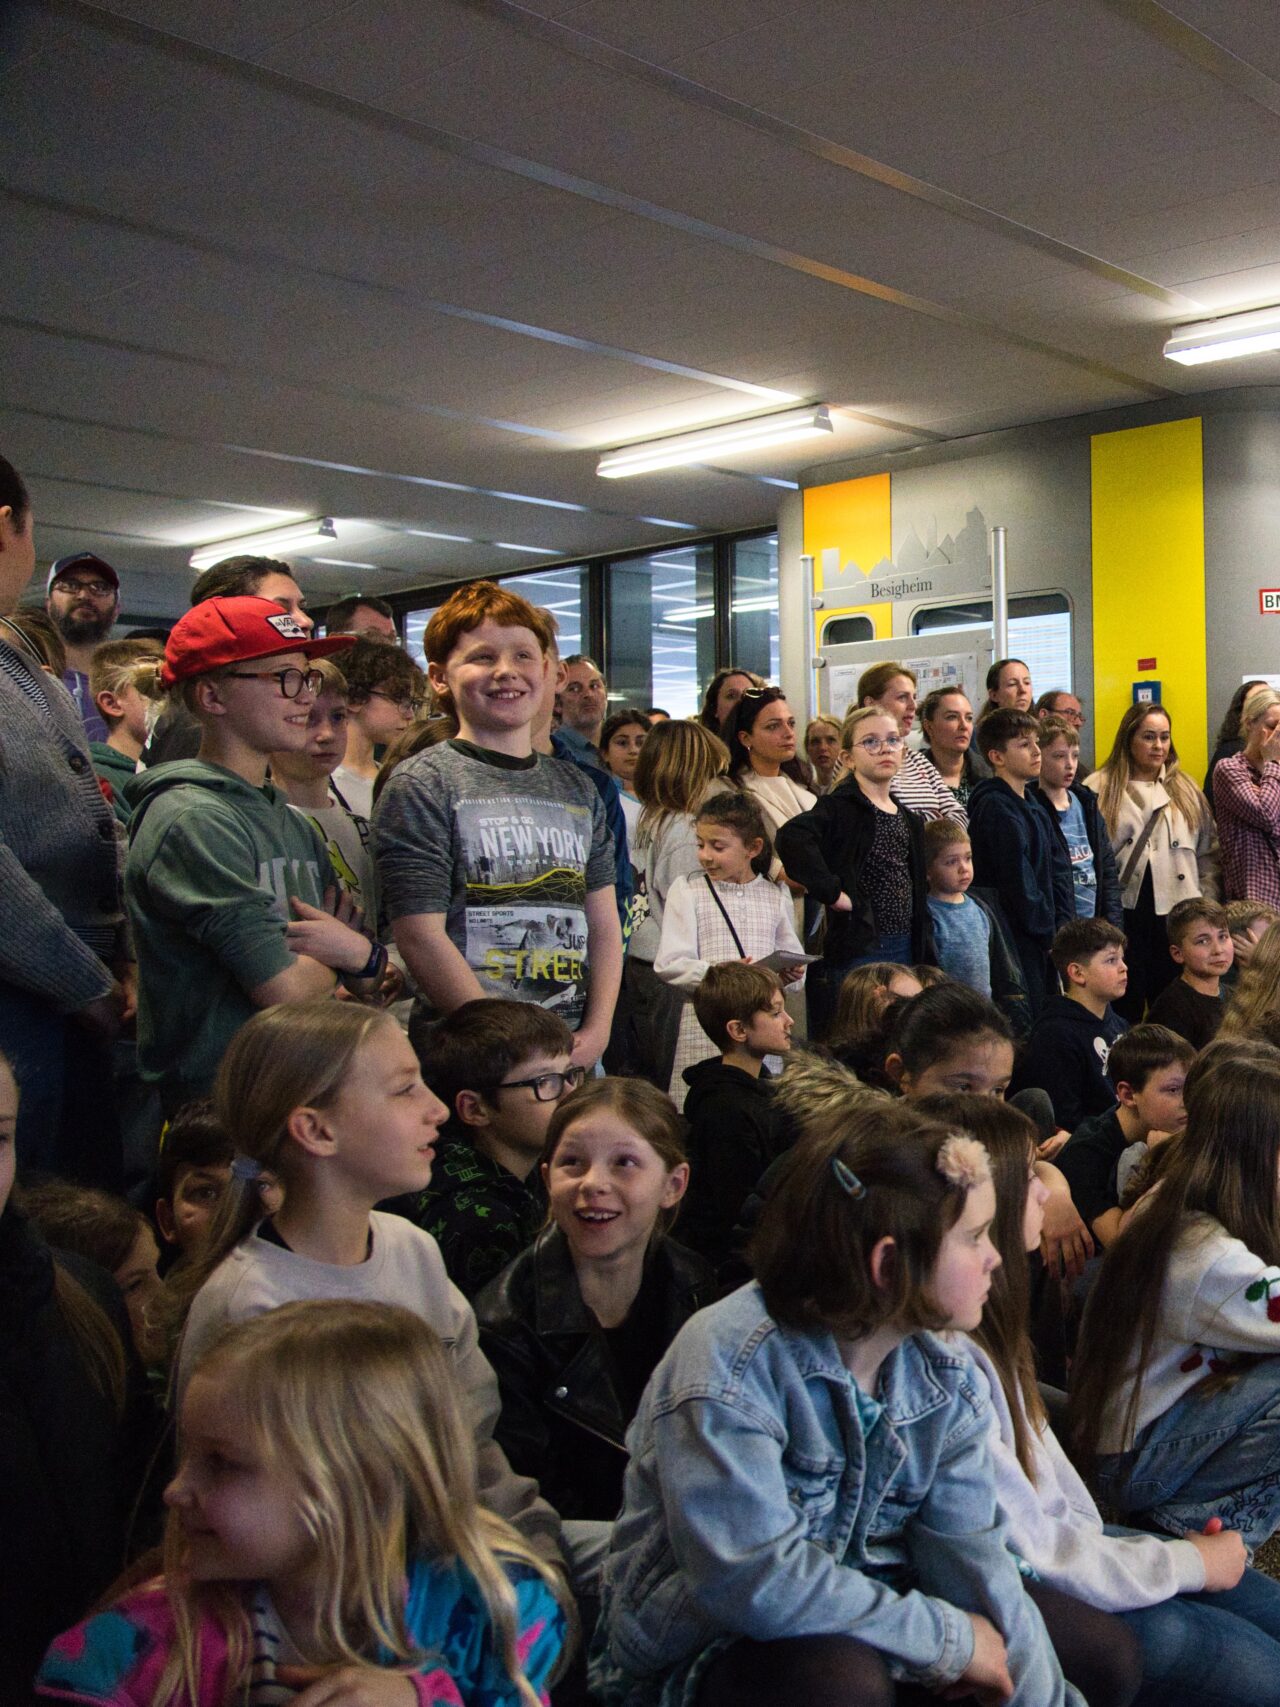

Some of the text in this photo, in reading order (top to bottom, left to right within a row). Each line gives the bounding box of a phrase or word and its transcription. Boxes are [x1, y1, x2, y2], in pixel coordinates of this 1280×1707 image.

[870, 577, 932, 598] Besigheim
[479, 817, 508, 827] STOP
[480, 827, 587, 864] NEW YORK
